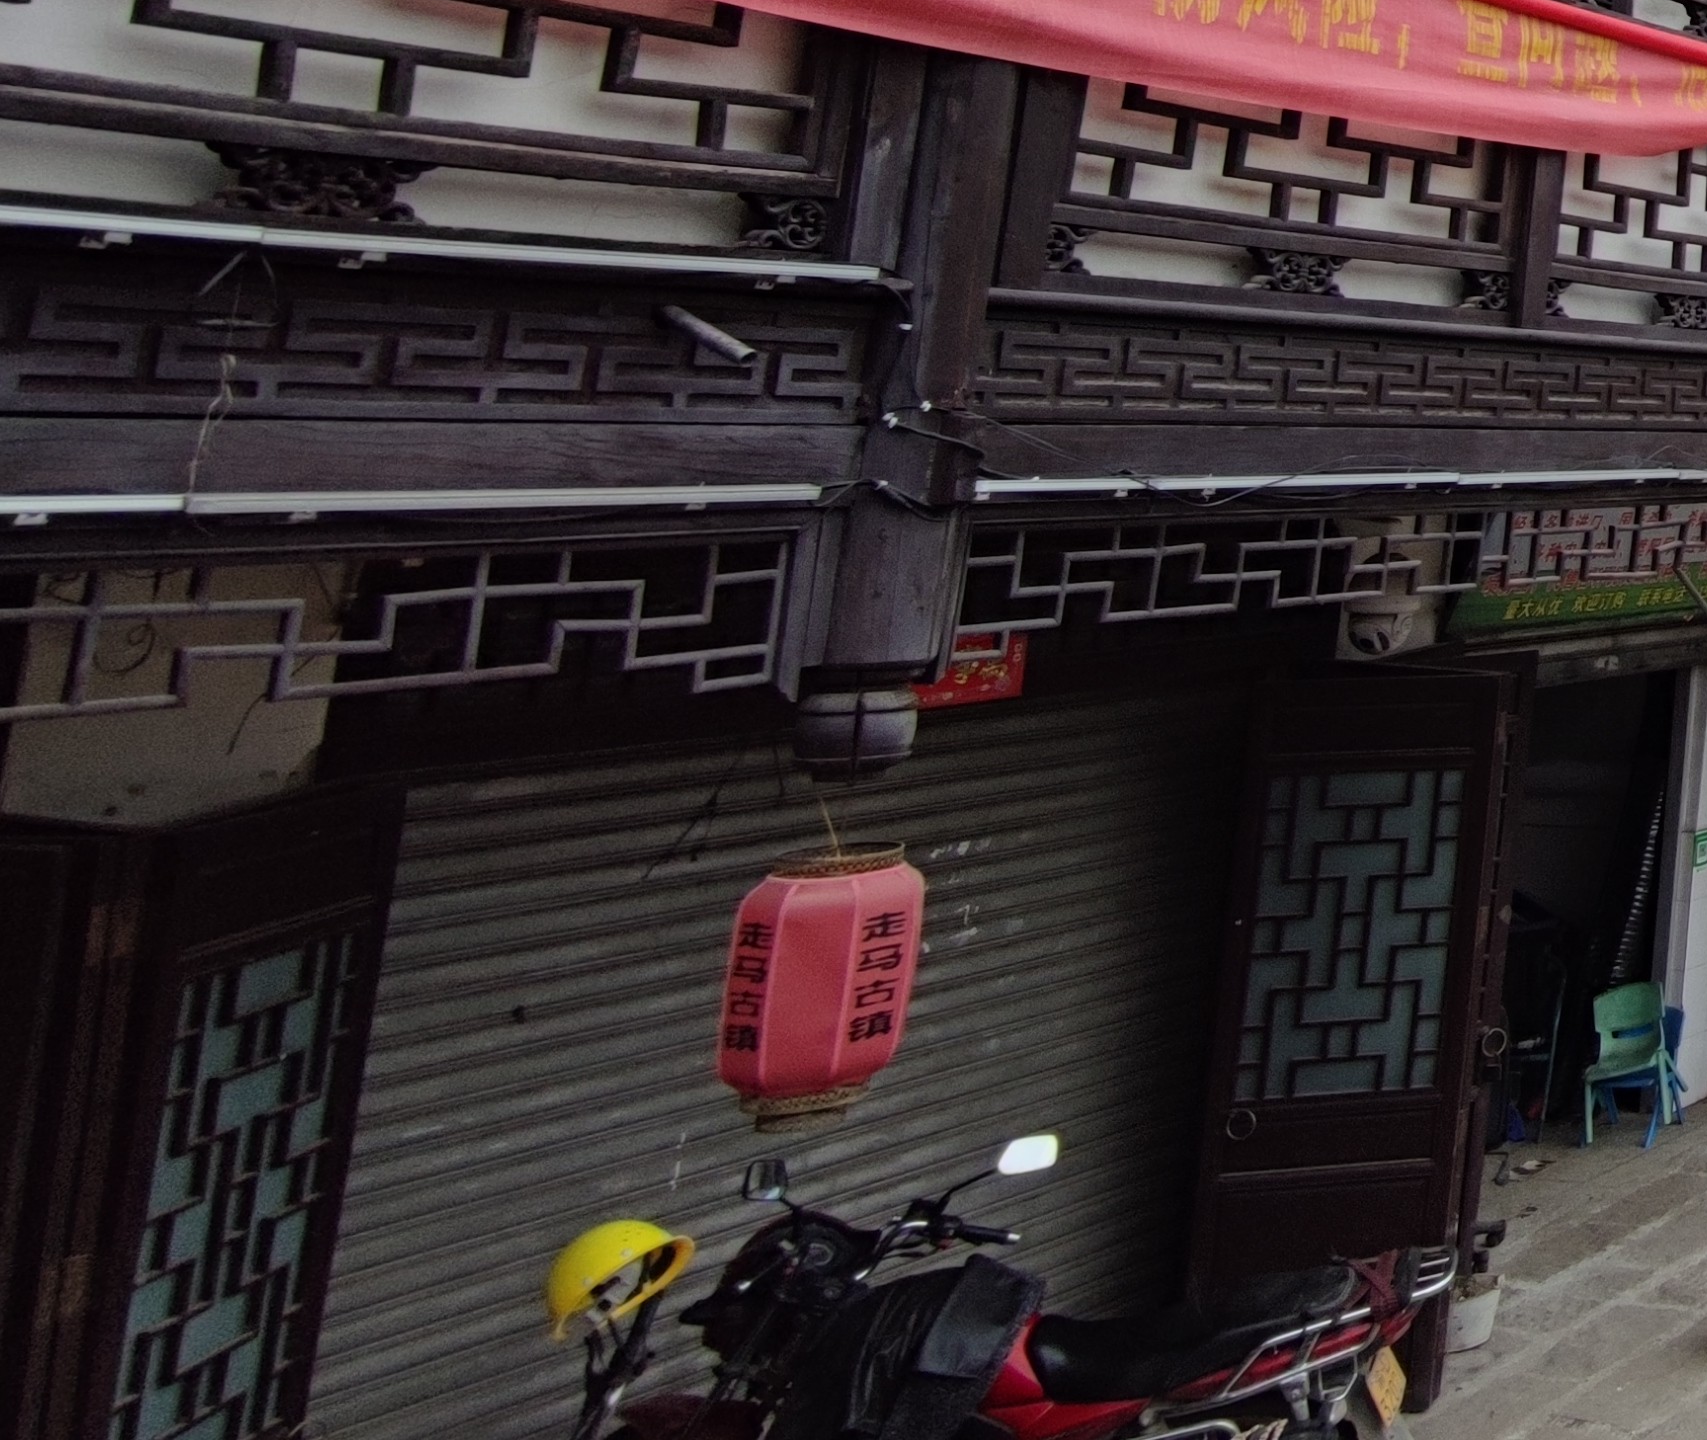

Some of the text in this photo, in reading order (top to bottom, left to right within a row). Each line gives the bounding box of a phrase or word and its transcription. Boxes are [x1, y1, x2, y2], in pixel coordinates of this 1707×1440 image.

[724, 921, 774, 1053] 走马古镇
[848, 911, 906, 1043] 走马古镇
